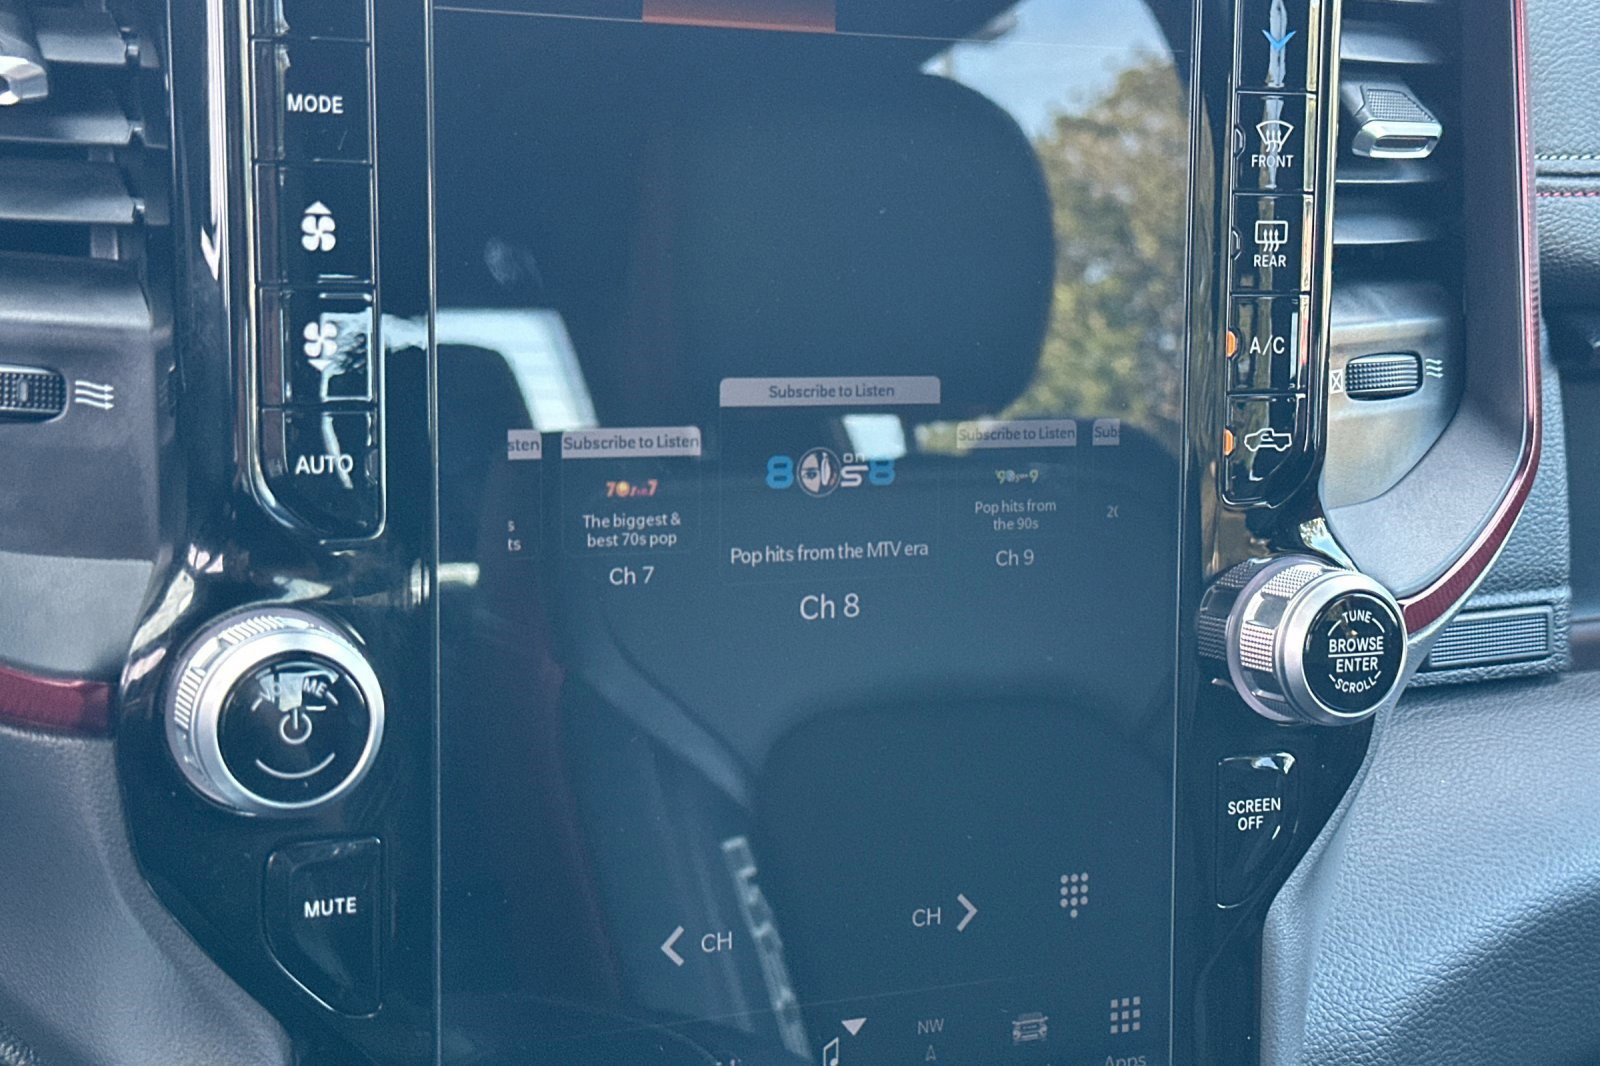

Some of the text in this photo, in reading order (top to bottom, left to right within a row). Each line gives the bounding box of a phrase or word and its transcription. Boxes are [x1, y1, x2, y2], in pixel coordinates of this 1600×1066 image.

[286, 93, 343, 114] MODE
[1251, 154, 1293, 169] FRONT
[1253, 254, 1287, 268] REAR
[1249, 336, 1285, 355] A/C
[768, 382, 895, 399] Subscribe to Listen
[958, 425, 1076, 441] Subscribe to Listen
[1094, 425, 1121, 438] Sub
[563, 433, 700, 450] Subscribe to Listen
[295, 454, 354, 475] AUTO
[974, 498, 1057, 518] Pop hits from
[583, 512, 681, 530] The biggest &
[992, 515, 1040, 531] the 90s
[587, 532, 677, 549] best 70s pop
[730, 541, 929, 567] Pop hits from the MTV era
[996, 548, 1035, 567] Ch 9
[609, 565, 655, 585] Ch 7
[800, 592, 861, 620] Ch 8
[1342, 609, 1373, 625] TUNE
[1328, 635, 1385, 654] BROWSE
[1335, 656, 1379, 673] ENTER
[1334, 676, 1377, 694] SCROLL
[1227, 797, 1282, 815] SCREEN
[1237, 815, 1265, 831] OFF
[303, 896, 358, 918] MUTE
[910, 906, 943, 928] CH
[700, 930, 734, 954] CH
[916, 1018, 945, 1035] NW
